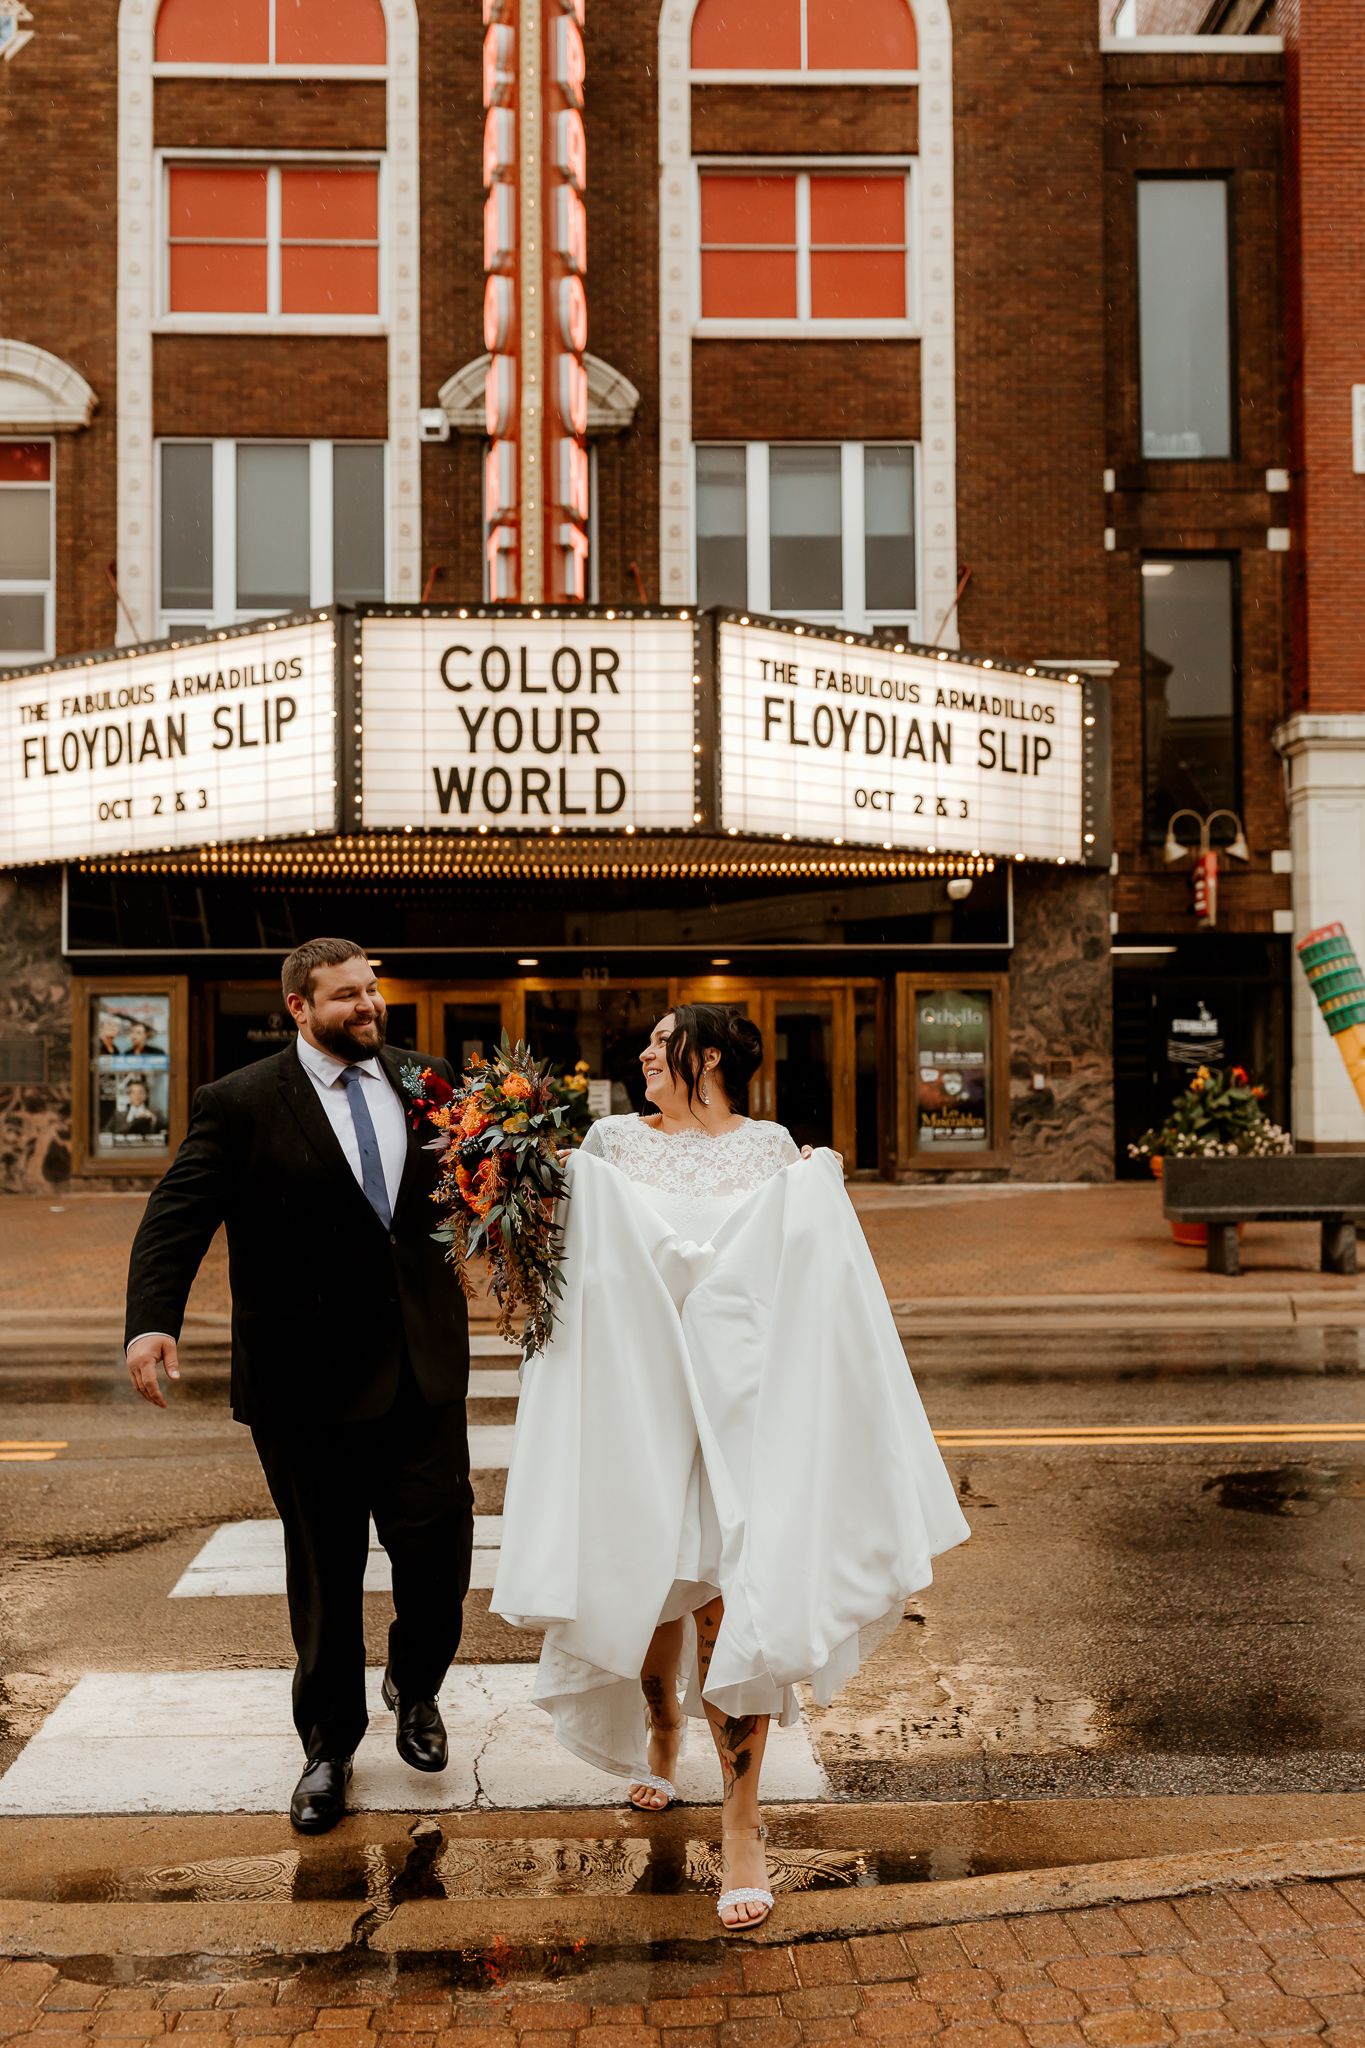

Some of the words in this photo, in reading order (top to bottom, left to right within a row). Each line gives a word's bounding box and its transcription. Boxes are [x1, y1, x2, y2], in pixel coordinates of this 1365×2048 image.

[19, 702, 49, 724] THE
[62, 684, 155, 718] FABULOUS
[169, 658, 303, 700] ARMADILLOS
[440, 645, 620, 694] COLOR
[759, 659, 799, 685] THE
[815, 669, 921, 703] FABULOUS
[935, 688, 1055, 724] ARMADILLOS
[23, 713, 187, 779] FLOYDIAN
[212, 696, 297, 750] SLIP
[458, 706, 601, 754] YOUR
[763, 696, 953, 765] FLOYDIAN
[978, 728, 1052, 776] SLIP
[98, 799, 133, 821] OCT
[152, 795, 163, 816] 2
[175, 792, 187, 812] &
[198, 789, 208, 810] 3
[433, 766, 626, 815] WORLD
[854, 789, 895, 814] OCT
[913, 795, 924, 815] 2
[936, 797, 948, 817] &
[959, 800, 969, 819] 3
